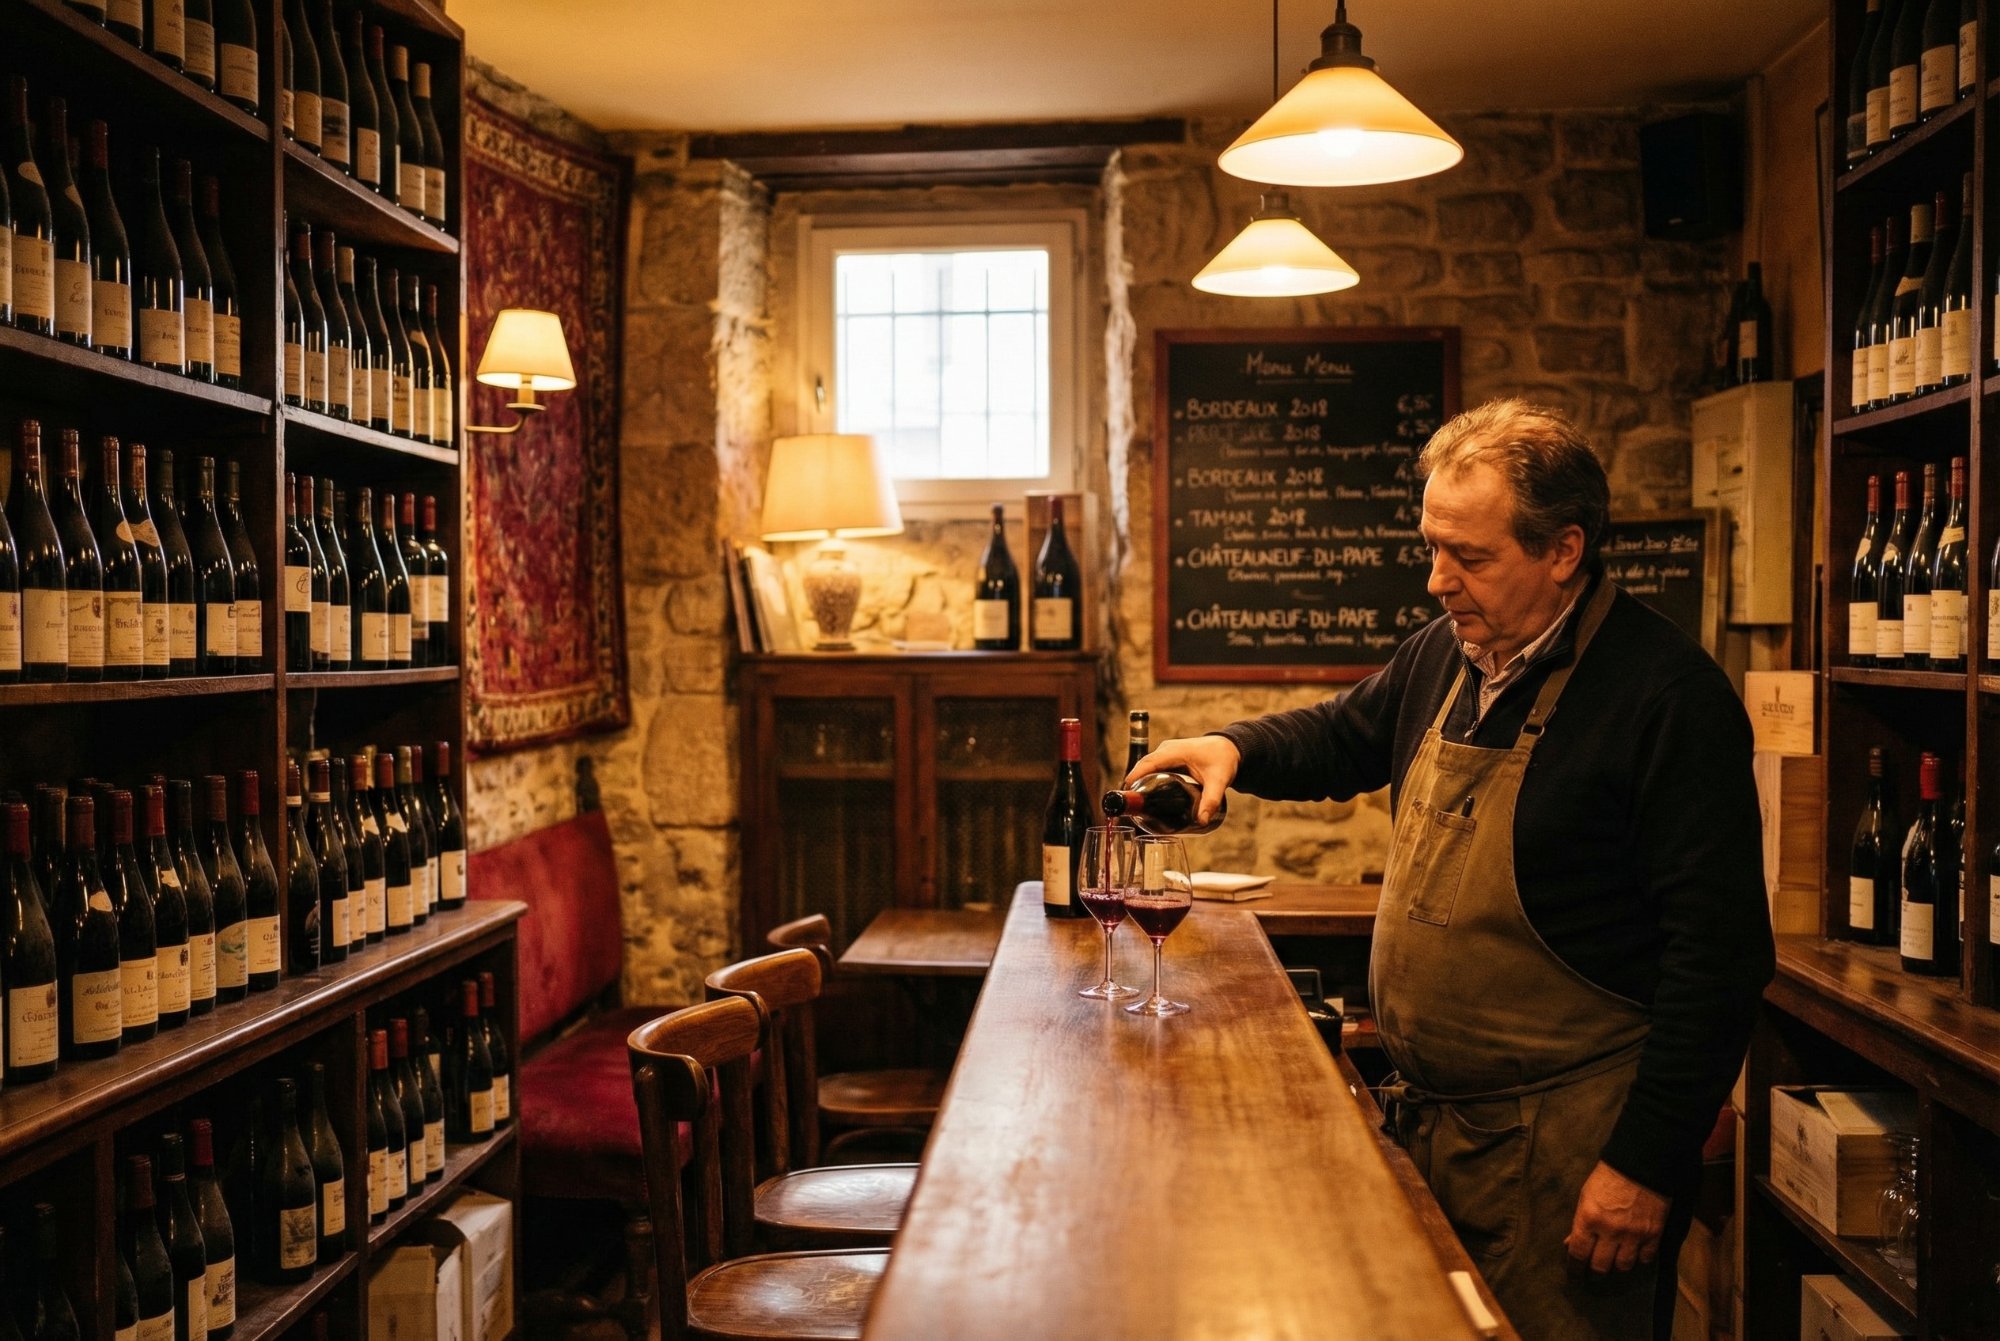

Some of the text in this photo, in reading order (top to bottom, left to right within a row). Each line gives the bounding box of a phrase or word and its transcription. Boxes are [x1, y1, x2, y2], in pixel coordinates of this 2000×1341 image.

[1187, 398, 1328, 420] BORDEAUX 2018
[1187, 466, 1324, 488] BORDEAUX 2018
[1267, 506, 1307, 526] 2018
[1187, 542, 1384, 569] CHÂTEAUNEUF-DU-PAPE
[1187, 603, 1379, 630] CHÂTEAUNEUF-DU-PAPE
